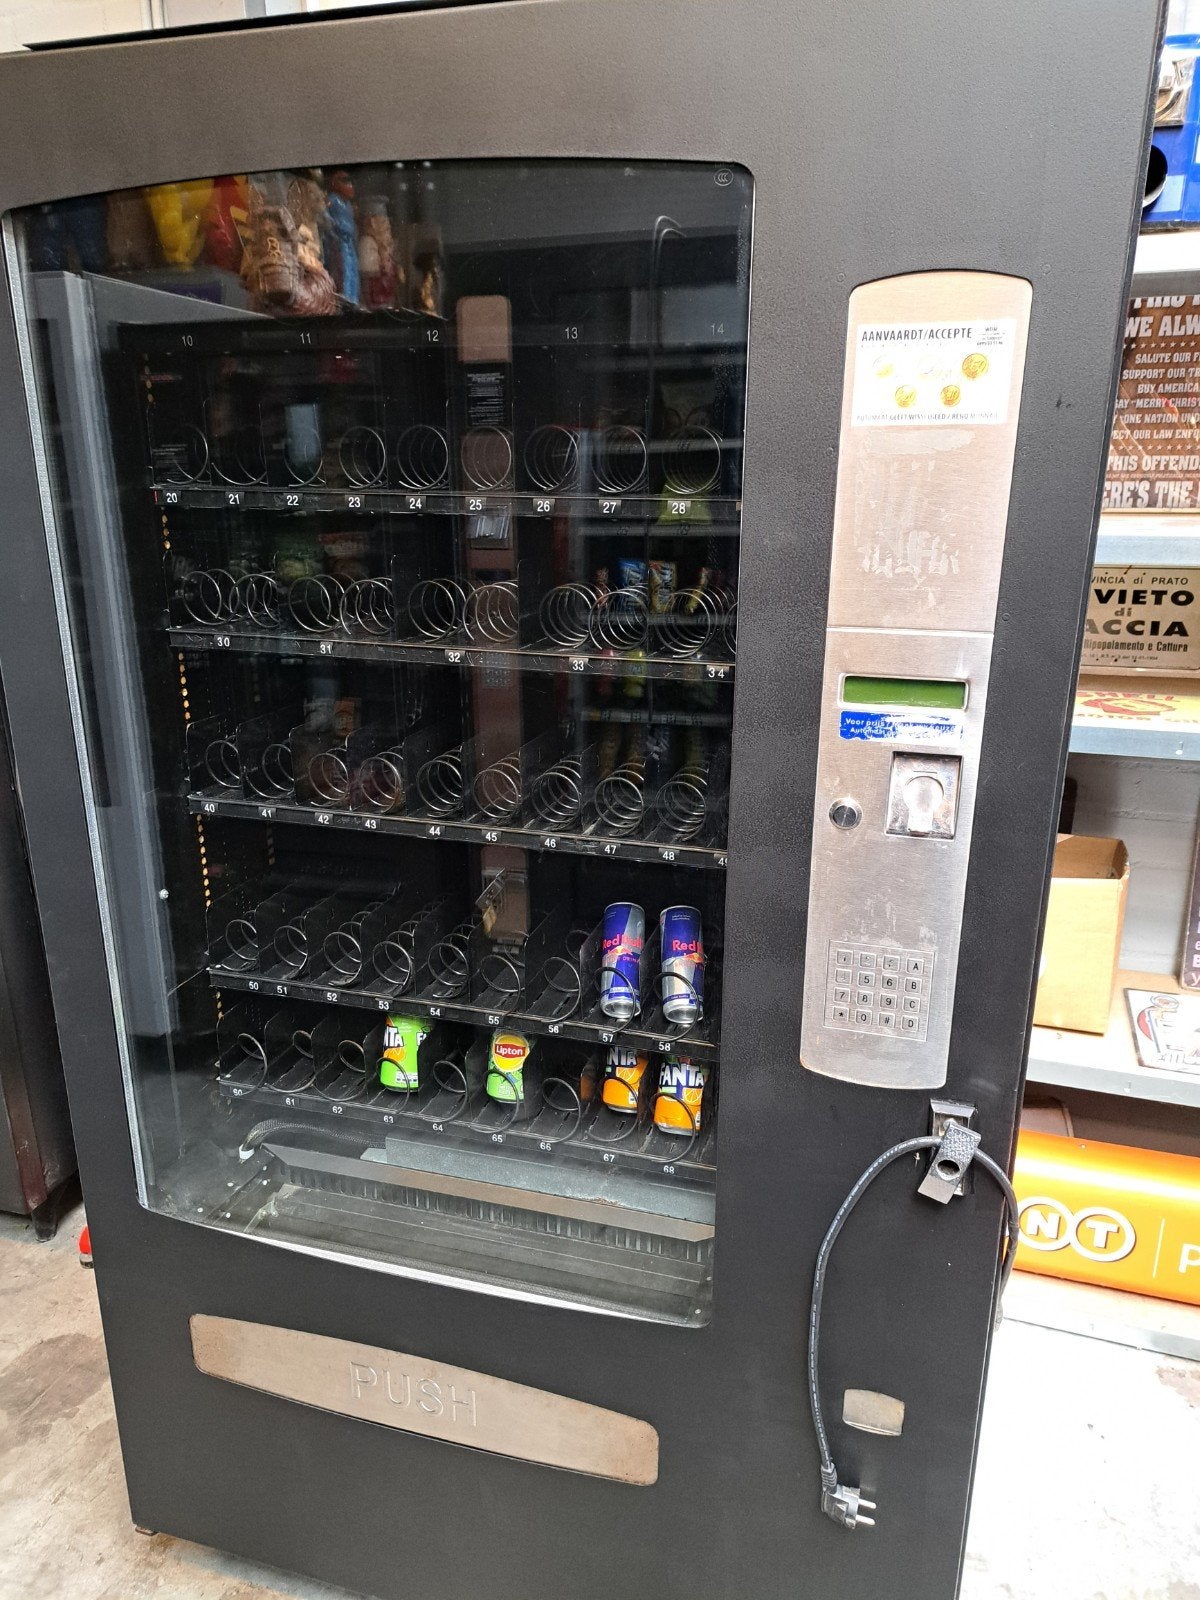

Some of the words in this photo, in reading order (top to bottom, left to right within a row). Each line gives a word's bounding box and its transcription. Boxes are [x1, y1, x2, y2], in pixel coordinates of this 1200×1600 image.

[710, 322, 725, 335] 14
[1125, 316, 1154, 337] WE
[300, 332, 312, 344] 11
[426, 330, 439, 342] 12
[564, 327, 578, 340] 13
[861, 327, 972, 342] AANVAARDT/ACCEPTE
[181, 334, 193, 347] 10
[1135, 353, 1171, 364] SALUTE
[1173, 352, 1191, 362] OUR
[1122, 369, 1165, 379] SUPPORT
[1167, 368, 1186, 378] OUR
[1137, 384, 1156, 394] BUY
[1144, 413, 1178, 423] NATION
[1133, 429, 1151, 439] OUR
[1153, 429, 1173, 439] LAW
[1142, 455, 1200, 471] OFFEND
[166, 492, 178, 504] 20
[228, 493, 240, 505] 21
[1155, 481, 1194, 508] THE
[286, 494, 299, 506] 22
[348, 496, 361, 508] 23
[409, 498, 422, 510] 24
[469, 499, 482, 511] 25
[537, 500, 550, 512] 26
[603, 502, 617, 514] 27
[671, 502, 686, 515] 28
[1151, 577, 1189, 585] PRATO
[1094, 589, 1195, 606] VIETO
[1114, 608, 1132, 617] di
[217, 636, 230, 647] 30
[1147, 643, 1153, 651] e
[1156, 641, 1188, 652] Cattura
[320, 643, 332, 654] 31
[448, 652, 460, 663] 32
[572, 660, 584, 671] 33
[708, 666, 725, 679] 34
[204, 804, 215, 813] 40
[261, 808, 272, 818] 41
[318, 815, 330, 825] 42
[365, 819, 377, 829] 43
[429, 826, 441, 836] 44
[485, 832, 498, 842] 45
[544, 838, 556, 848] 46
[604, 845, 617, 855] 47
[662, 851, 675, 861] 48
[672, 940, 696, 951] Red
[249, 981, 259, 991] 50
[277, 985, 288, 995] 51
[327, 992, 338, 1002] 52
[378, 1001, 390, 1010] 53
[430, 1007, 441, 1017] 54
[488, 1015, 500, 1025] 55
[548, 1025, 559, 1034] 56
[602, 1033, 614, 1043] 57
[496, 1045, 523, 1056] Lipton
[658, 1042, 671, 1052] 58
[660, 1062, 704, 1086] FANTA
[285, 1097, 295, 1106] 61
[332, 1105, 343, 1115] 62
[383, 1115, 394, 1124] 63
[432, 1123, 444, 1132] 64
[491, 1134, 503, 1143] 65
[540, 1142, 552, 1151] 66
[603, 1154, 615, 1163] 67
[663, 1165, 675, 1175] 68
[349, 1361, 478, 1427] PUSH
